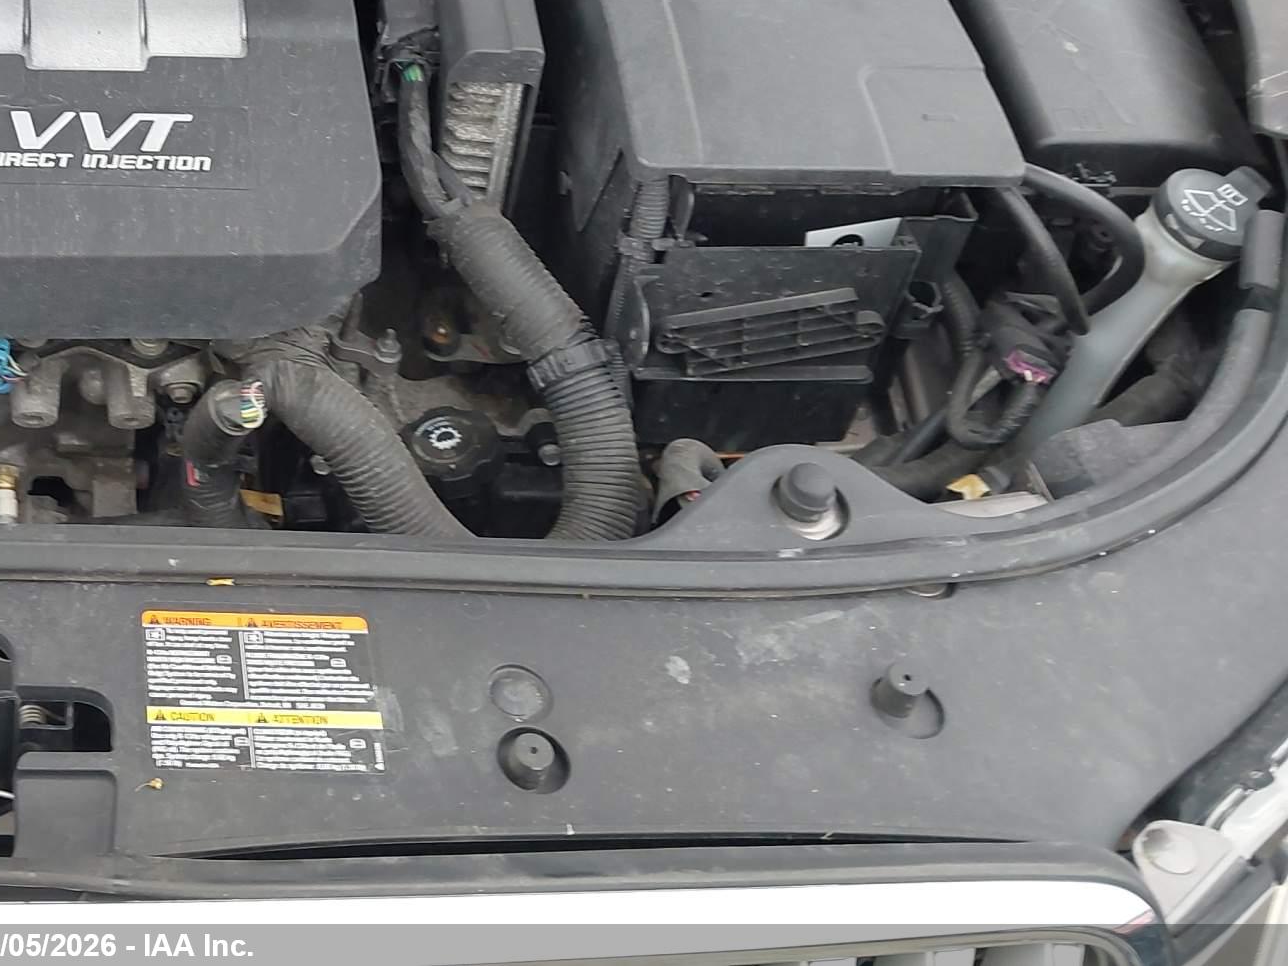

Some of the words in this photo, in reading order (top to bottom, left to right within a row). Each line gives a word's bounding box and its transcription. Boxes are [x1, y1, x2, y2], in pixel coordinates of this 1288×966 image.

[9, 110, 195, 152] VVT
[81, 152, 212, 172] INJECTION
[162, 616, 211, 627] WARNING
[169, 711, 215, 722] CAUTION
[273, 714, 328, 725] ATTENTION
